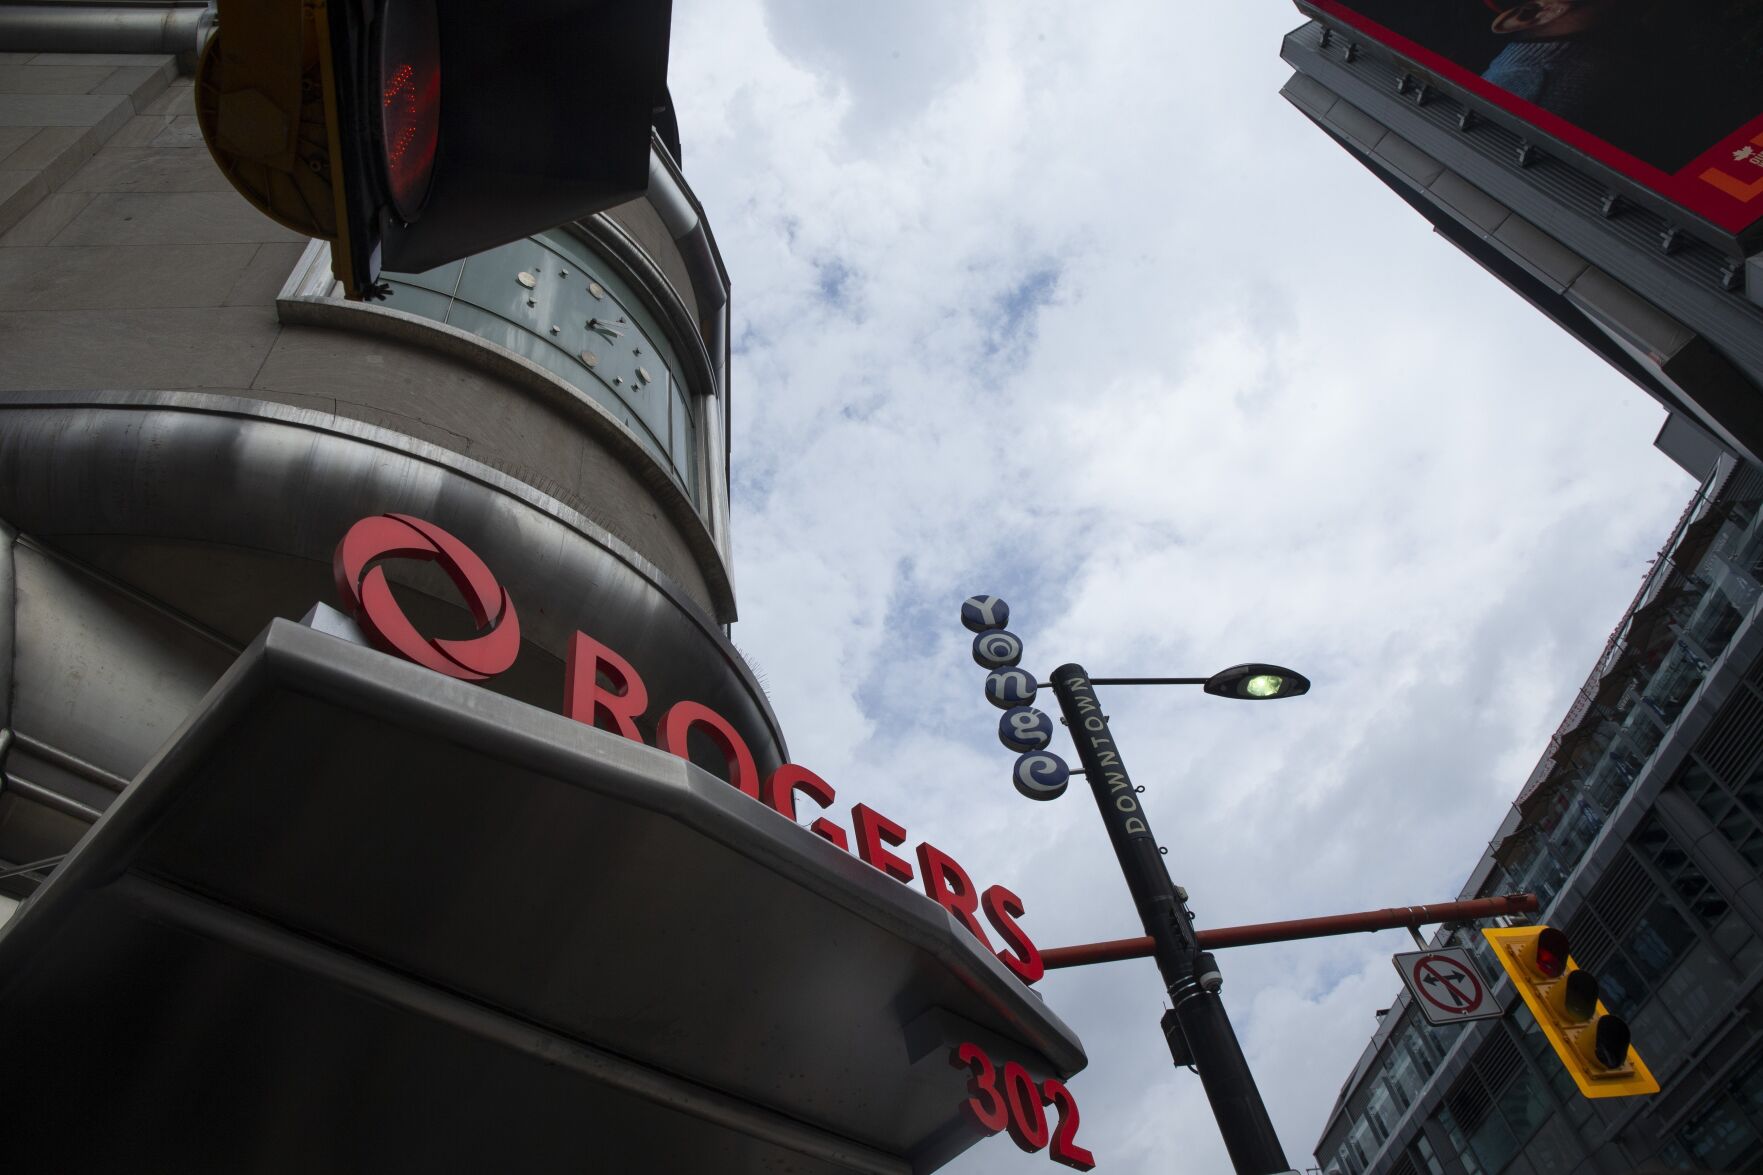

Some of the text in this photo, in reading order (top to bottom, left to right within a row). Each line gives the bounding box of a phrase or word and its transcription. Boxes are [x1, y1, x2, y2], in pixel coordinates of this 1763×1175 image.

[963, 596, 1069, 792] Yonge
[1065, 676, 1147, 834] DOWNTOWN
[565, 629, 1044, 986] ROGERS
[949, 1042, 1096, 1173] 302
